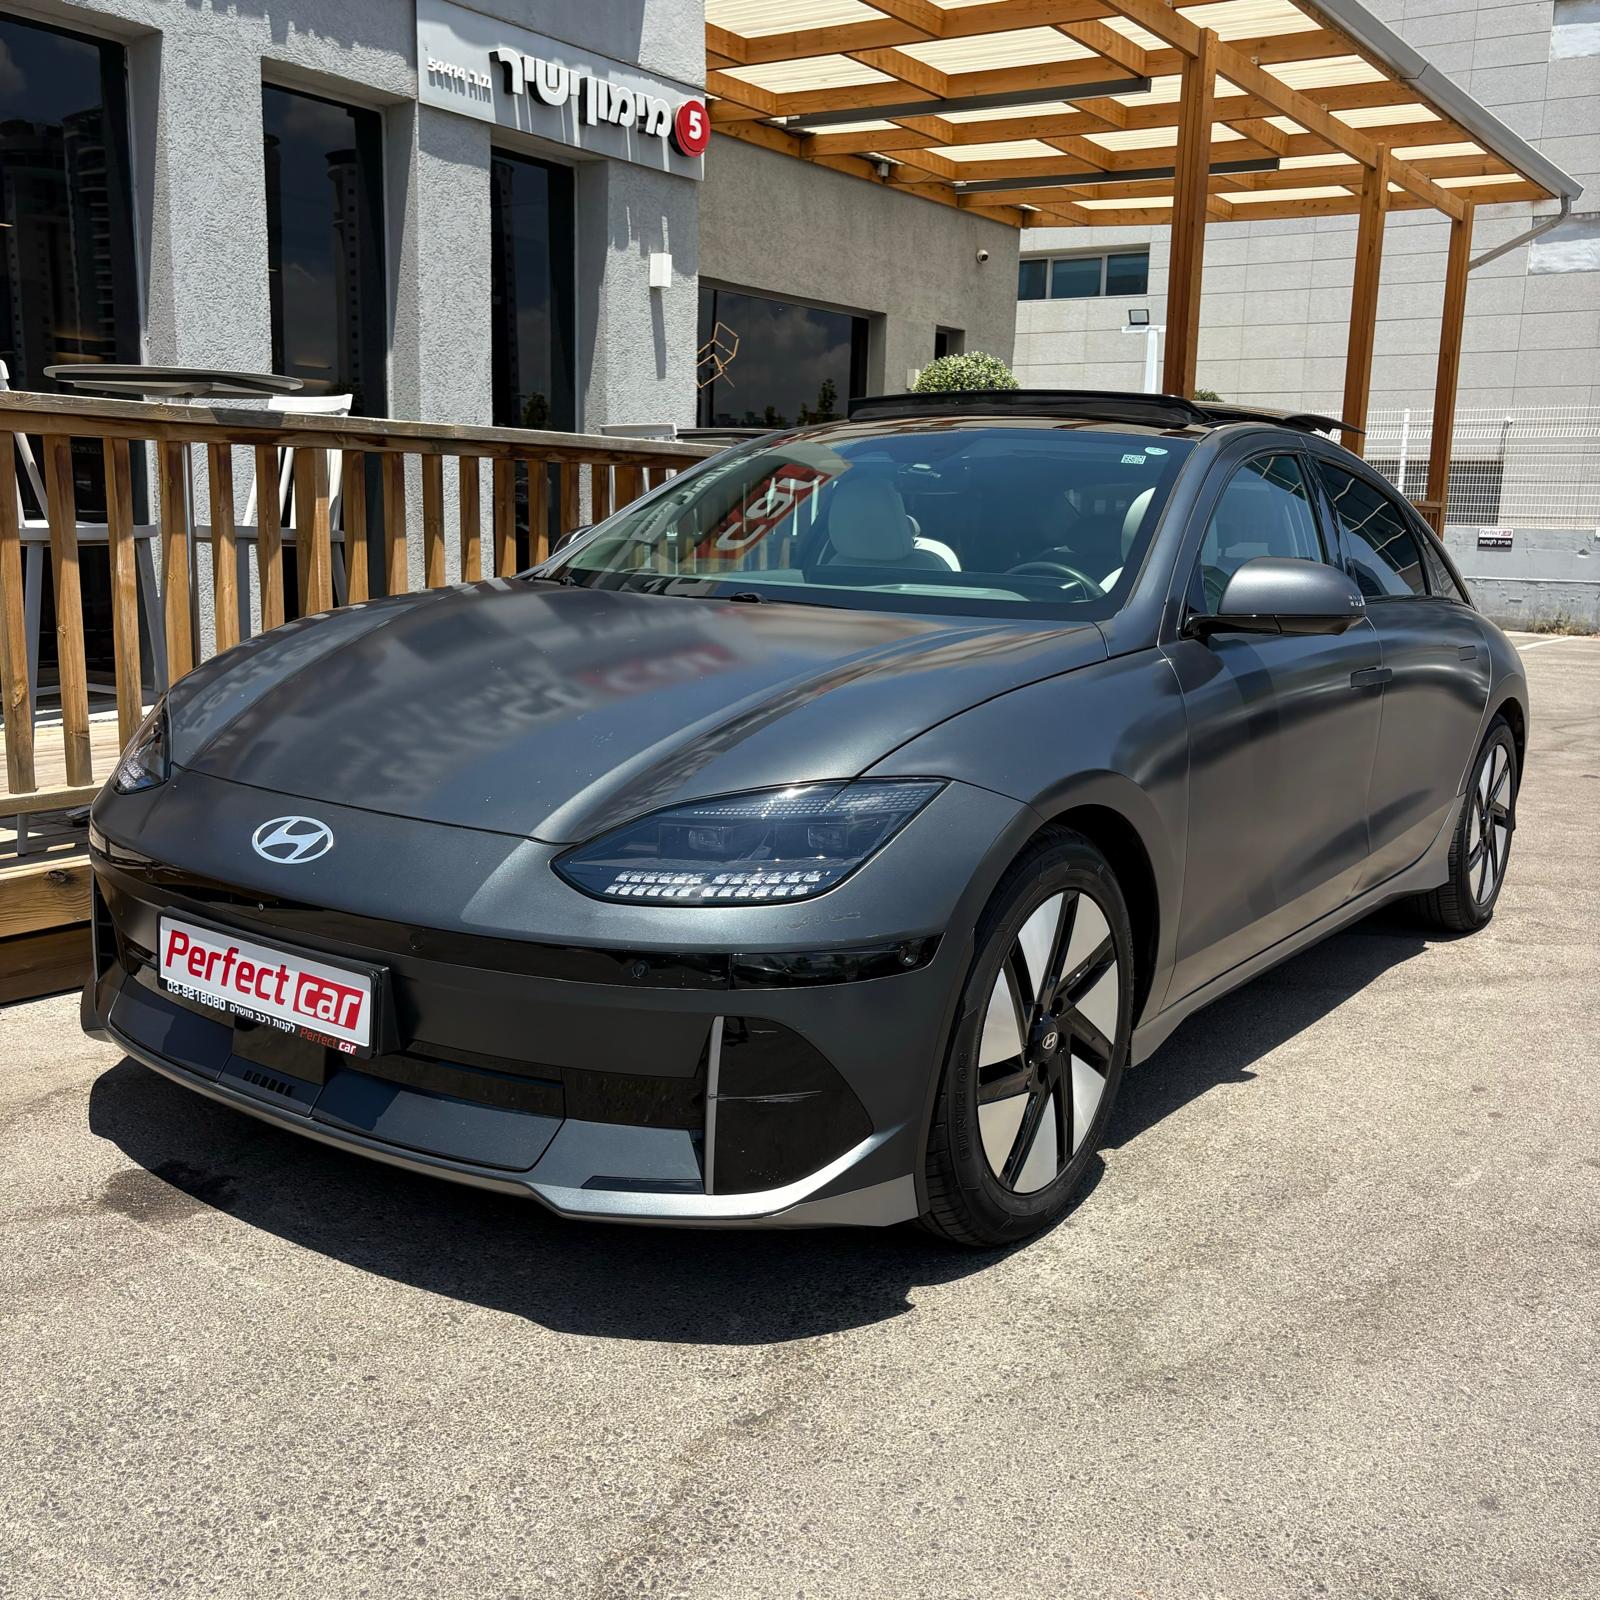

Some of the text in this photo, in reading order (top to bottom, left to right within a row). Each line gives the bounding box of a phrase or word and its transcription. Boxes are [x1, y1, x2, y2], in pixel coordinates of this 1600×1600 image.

[489, 48, 672, 137] מימון ישיר
[688, 110, 702, 140] 5
[165, 929, 360, 1026] Perfect car
[166, 981, 226, 1011] 03-9218080
[229, 1002, 296, 1033] לקנות רכב מושלם
[300, 1027, 355, 1055] Perfect car
